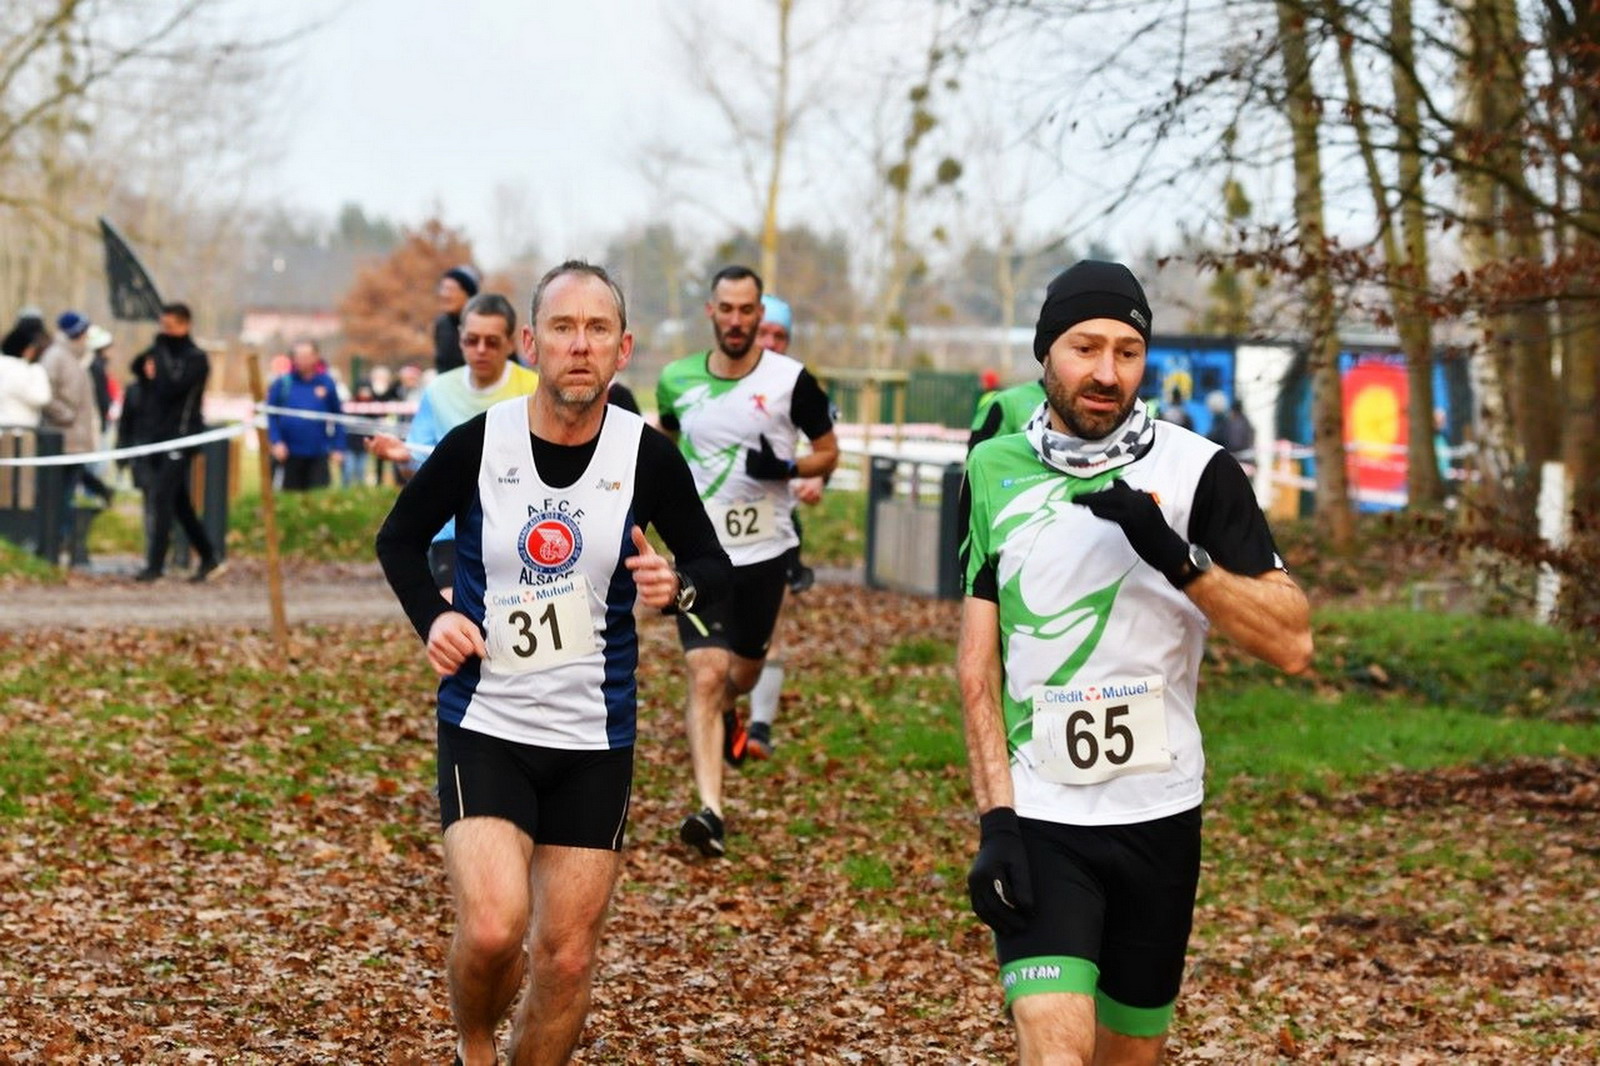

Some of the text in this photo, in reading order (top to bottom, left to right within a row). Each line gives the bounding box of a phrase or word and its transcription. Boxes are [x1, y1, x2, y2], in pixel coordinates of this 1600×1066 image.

[725, 507, 760, 537] 62
[492, 582, 575, 606] Crédit Mutuel
[508, 602, 563, 658] 31
[1044, 681, 1149, 703] Crédit Mutuel
[1065, 704, 1135, 770] 65
[1020, 965, 1061, 980] TEAM
